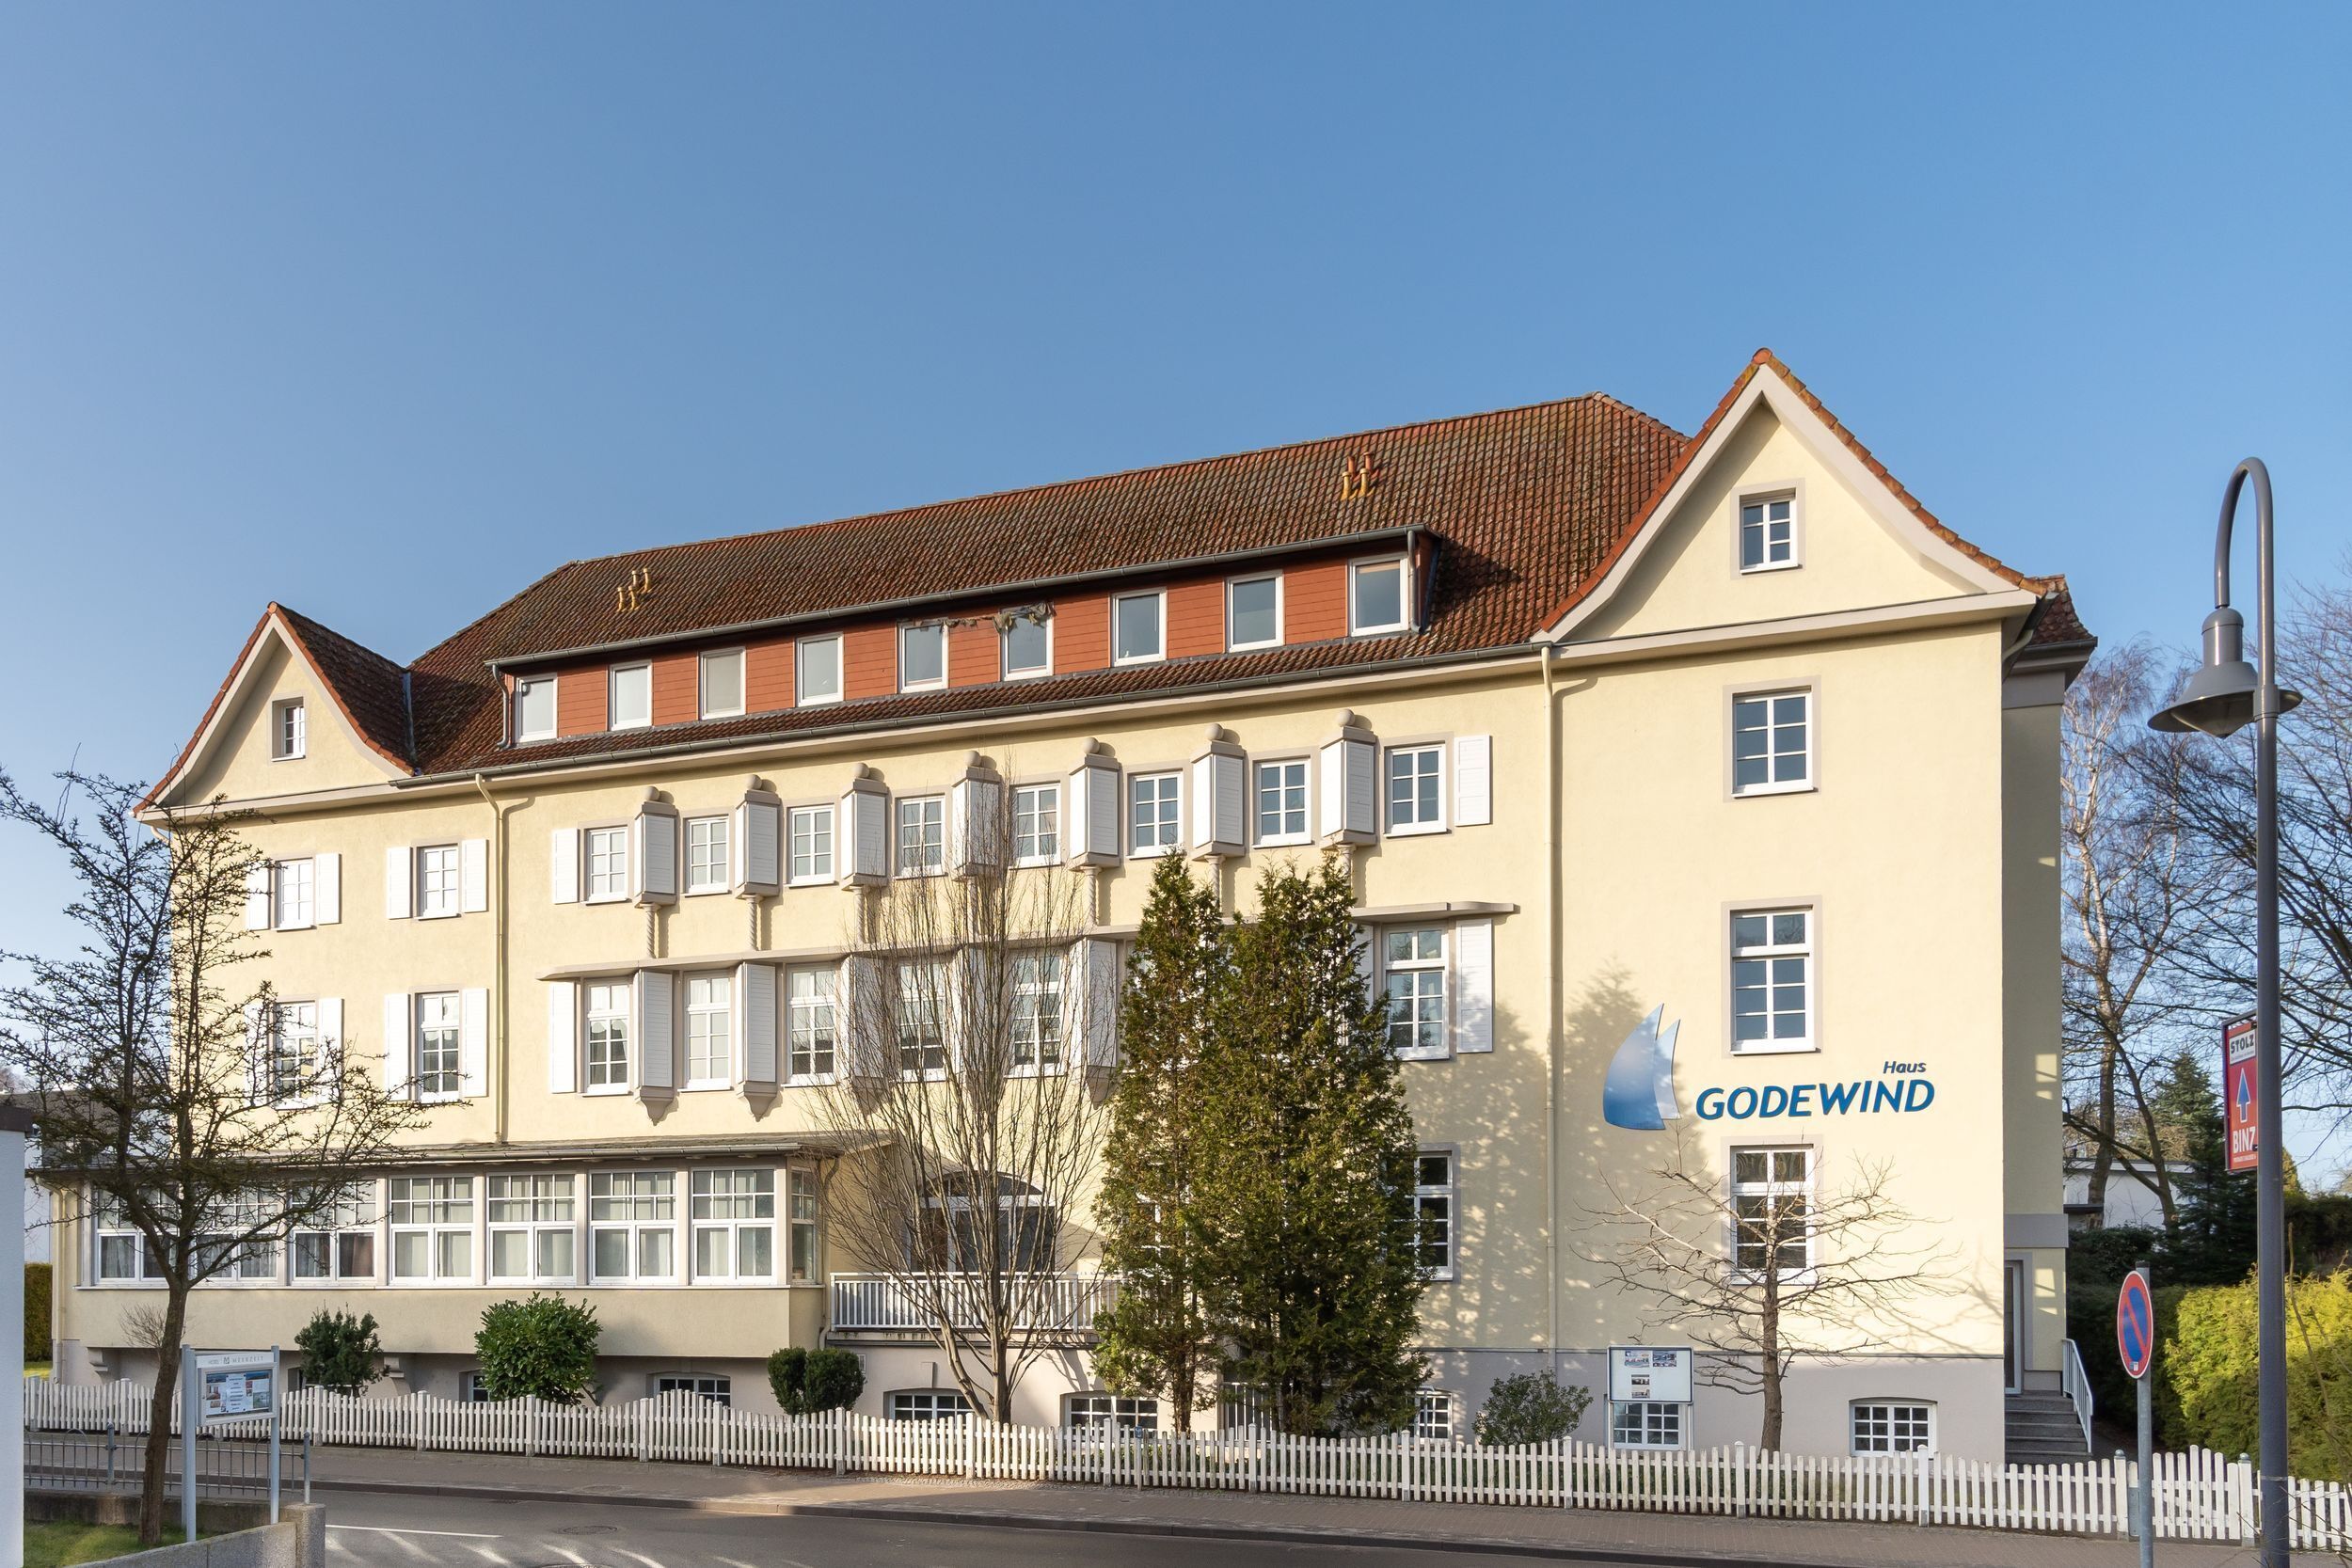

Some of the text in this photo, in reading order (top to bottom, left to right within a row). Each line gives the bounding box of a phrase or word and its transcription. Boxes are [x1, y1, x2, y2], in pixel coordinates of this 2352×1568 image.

[2231, 1034, 2254, 1053] STOLZ
[1883, 1060, 1927, 1074] Haus
[1695, 1079, 1935, 1120] GODEWIND
[2233, 1126, 2256, 1154] BINZ
